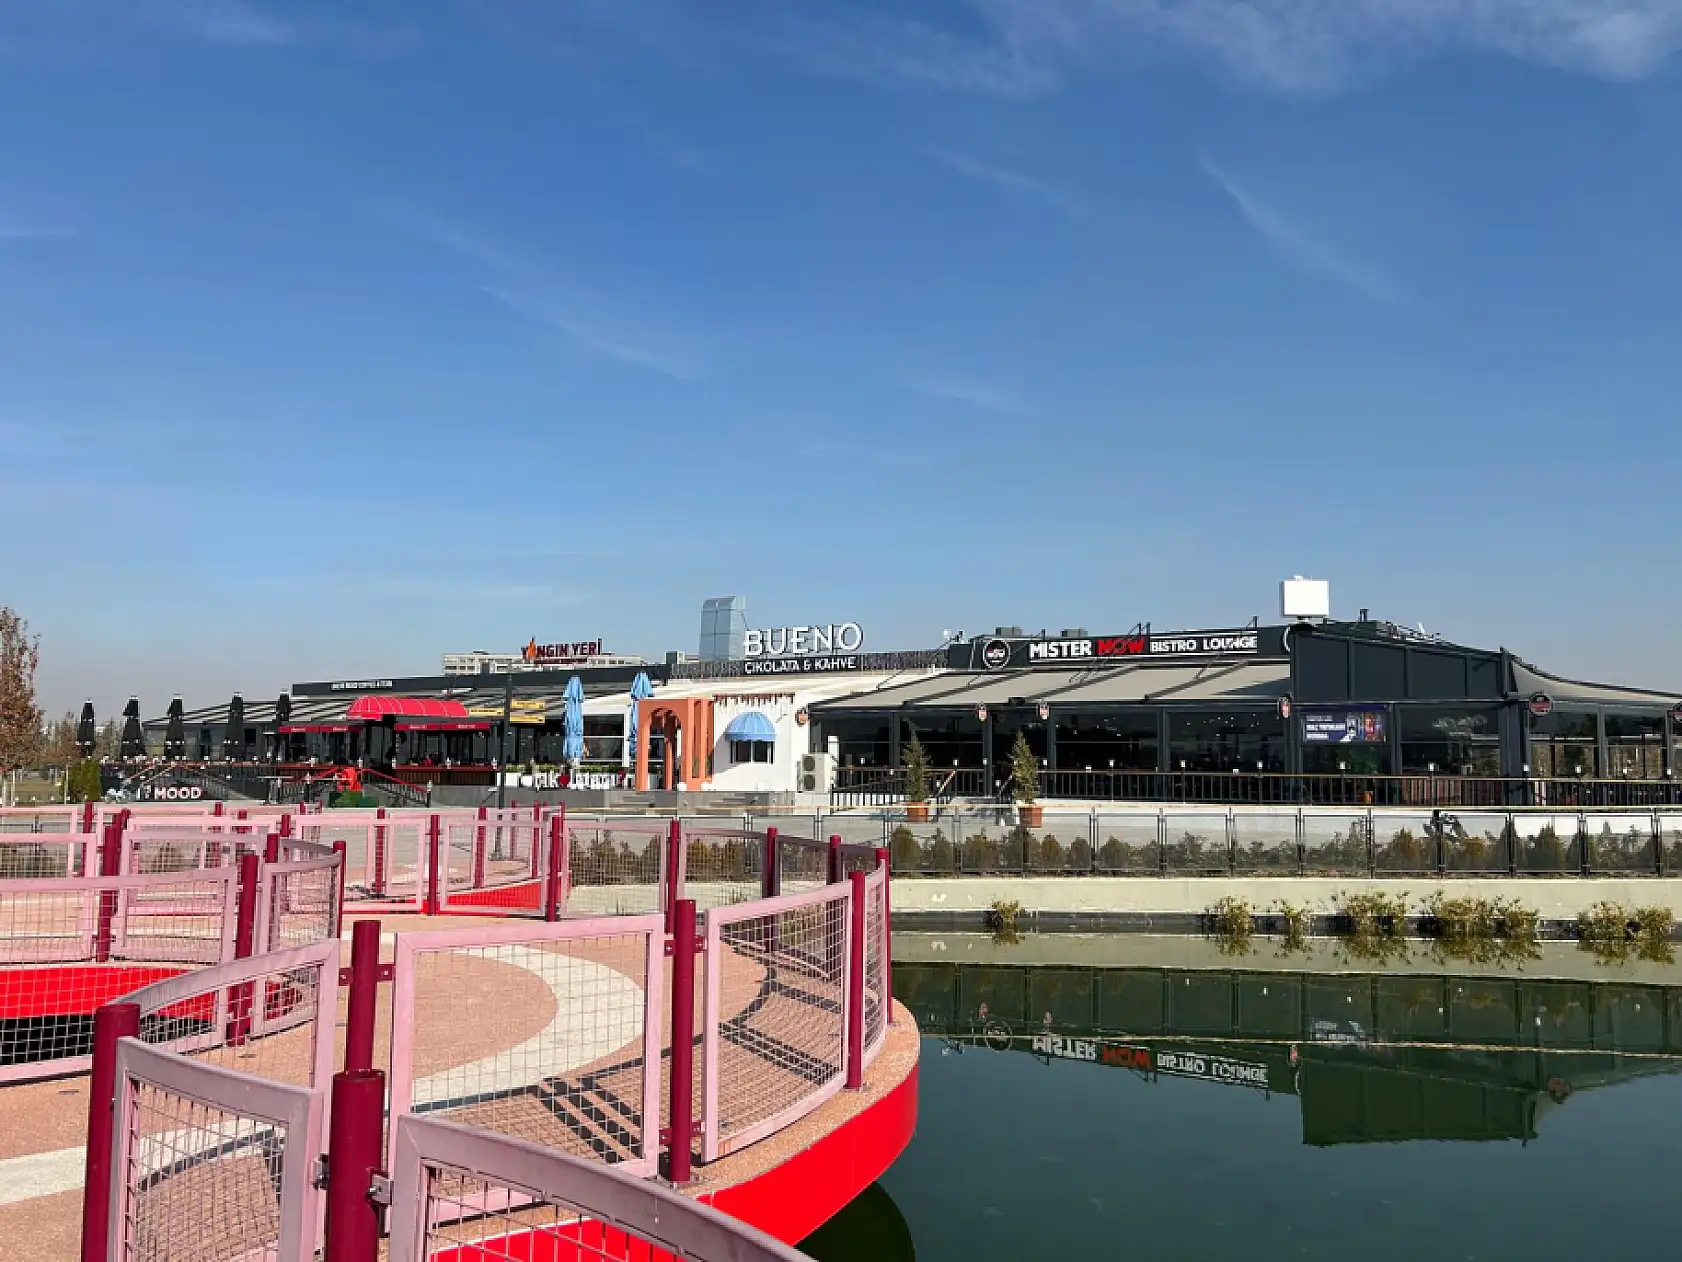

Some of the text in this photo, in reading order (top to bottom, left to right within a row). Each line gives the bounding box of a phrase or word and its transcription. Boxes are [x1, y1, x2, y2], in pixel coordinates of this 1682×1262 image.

[743, 622, 863, 656] BUENO
[1151, 635, 1258, 653] BISTRO LOUNGE
[1029, 639, 1092, 658] MISTER
[814, 656, 857, 671] KAHVE
[154, 786, 202, 800] MOOD
